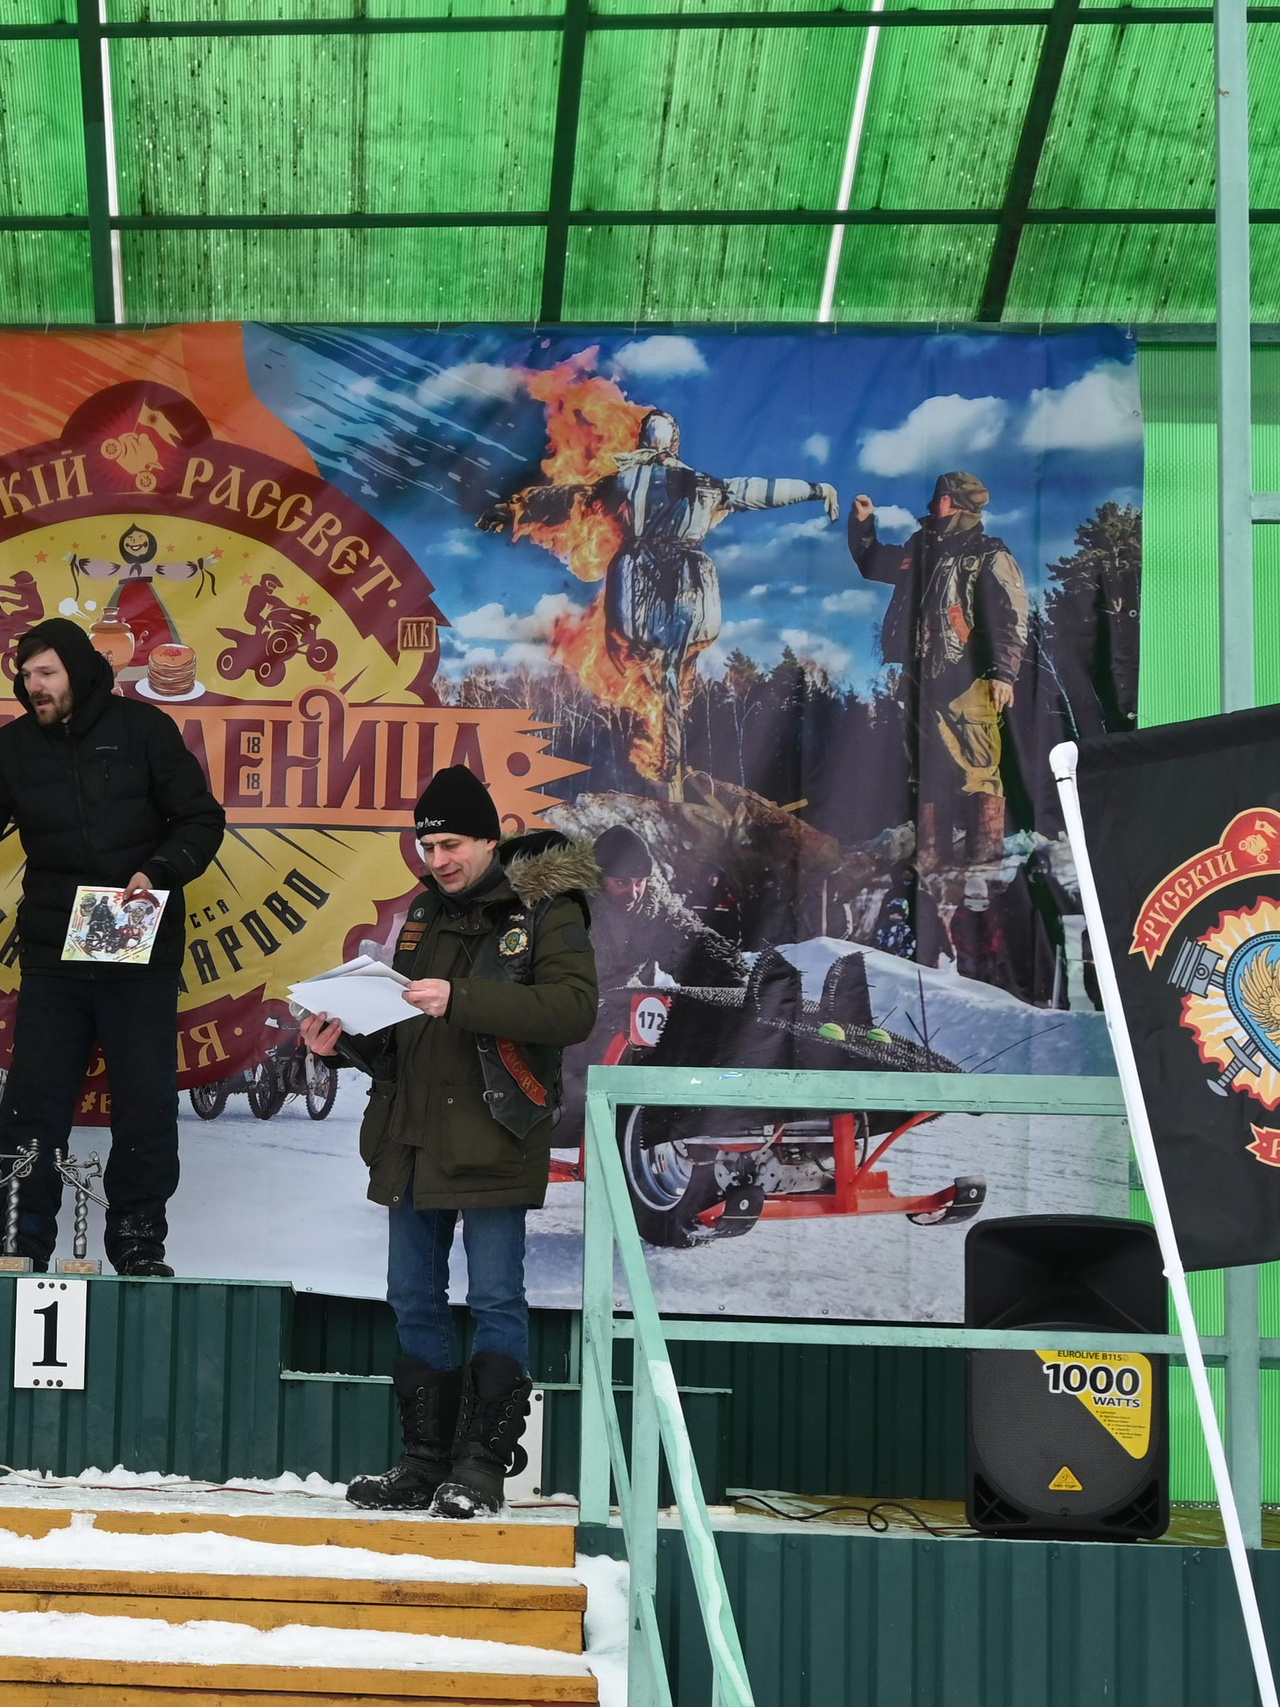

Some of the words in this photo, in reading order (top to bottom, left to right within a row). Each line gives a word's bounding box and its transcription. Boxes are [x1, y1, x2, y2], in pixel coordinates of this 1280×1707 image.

[177, 457, 402, 602] РАССВЕТ
[403, 622, 430, 648] МК
[246, 736, 261, 754] 18
[245, 773, 261, 790] 18
[32, 1300, 68, 1368] 1
[1044, 1362, 1142, 1397] 1000
[1092, 1396, 1141, 1408] WATTS
